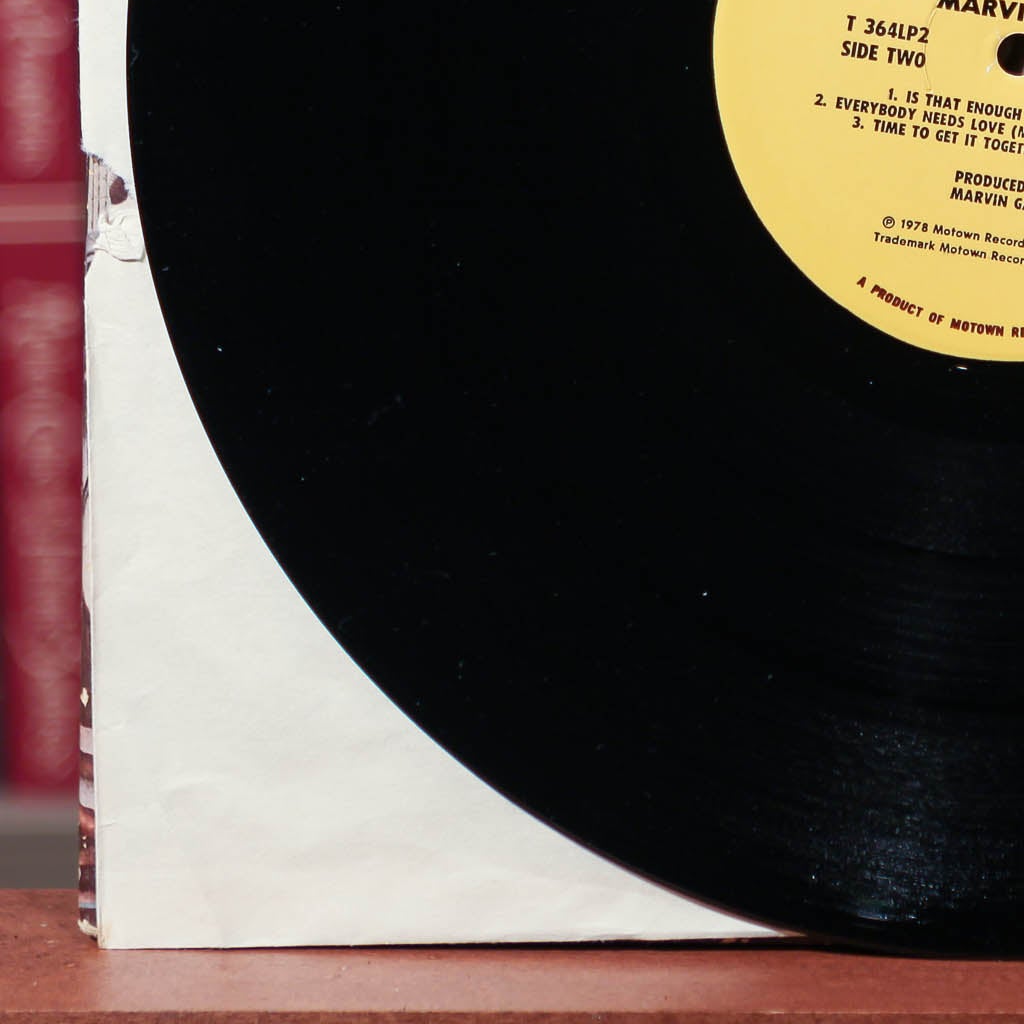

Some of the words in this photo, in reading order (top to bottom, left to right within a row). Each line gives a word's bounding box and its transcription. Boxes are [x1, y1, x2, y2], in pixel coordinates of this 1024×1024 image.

[847, 15, 856, 31] T
[864, 18, 929, 43] 364LP2
[841, 40, 879, 61] SIDE
[887, 47, 926, 68] TWO
[814, 94, 826, 106] 2.
[836, 97, 917, 120] EVERYBODY
[922, 111, 964, 128] NEEDS
[971, 118, 1005, 135] LOVE
[889, 88, 897, 101] 1.
[906, 91, 919, 104] IS
[926, 94, 961, 110] THAT
[967, 101, 1022, 120] ENOUGH
[852, 116, 864, 129] 3.
[874, 119, 906, 136] TIME
[912, 125, 929, 139] TO
[936, 130, 959, 144] GET
[965, 134, 977, 147] IT
[950, 187, 1008, 207] MARVIN
[874, 232, 935, 250] Trademark
[940, 242, 986, 259] Motown
[902, 219, 928, 232] 1978
[933, 224, 980, 240] Motown
[985, 233, 1024, 248] Record
[857, 276, 866, 288] A
[870, 284, 924, 317] PRODUCT
[929, 312, 944, 325] OF
[950, 318, 1004, 336] MOTOWN
